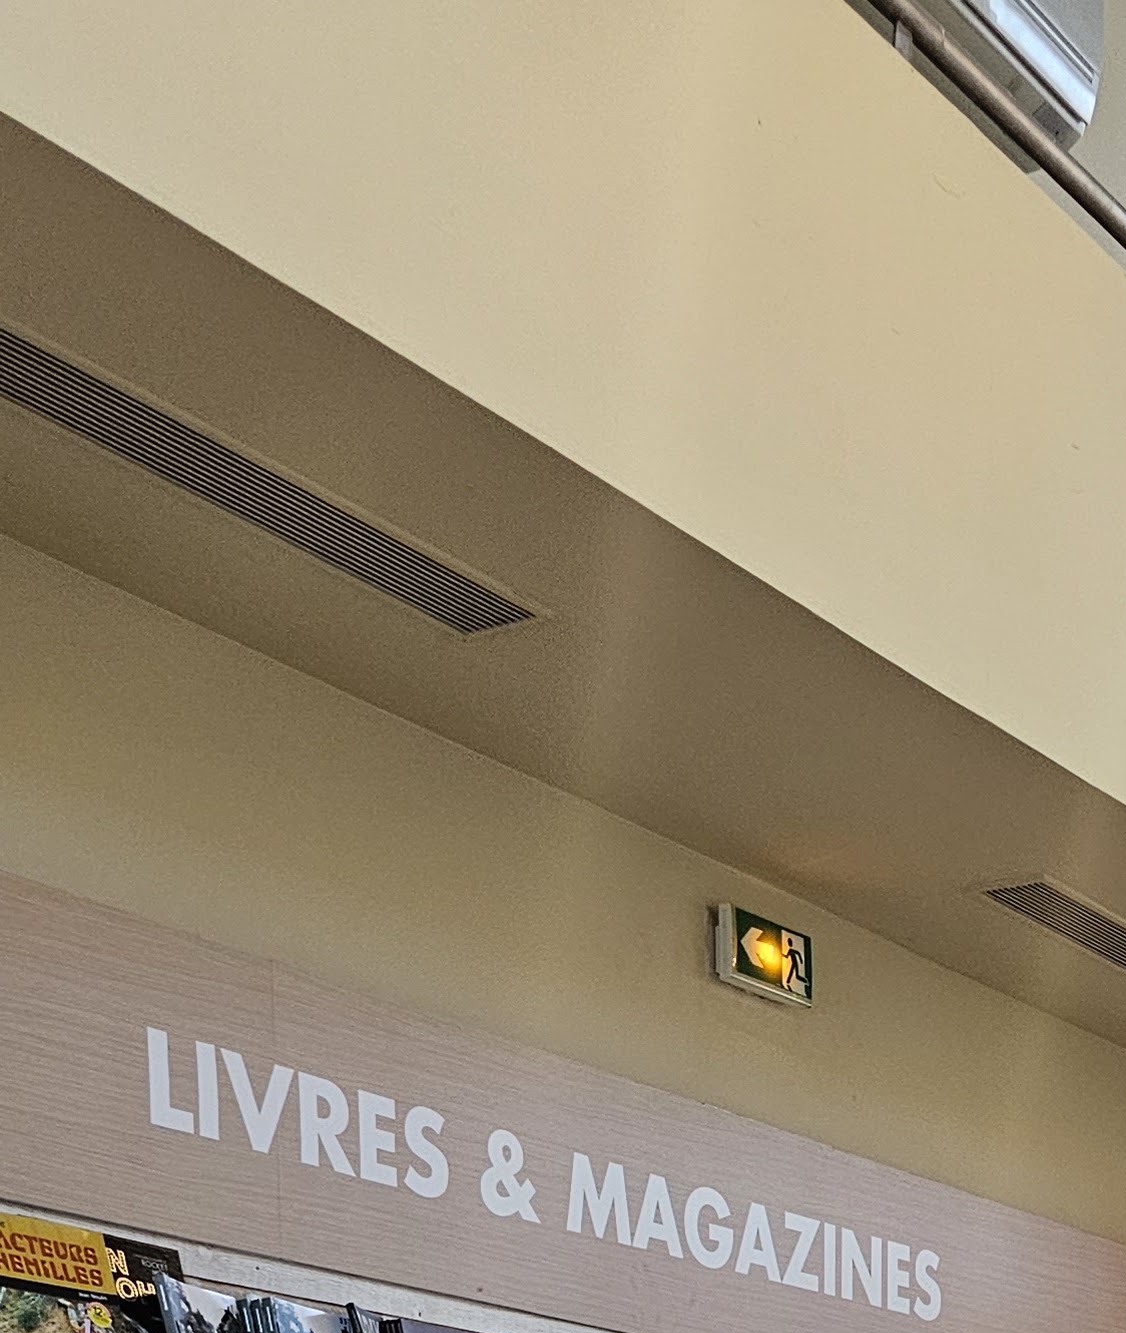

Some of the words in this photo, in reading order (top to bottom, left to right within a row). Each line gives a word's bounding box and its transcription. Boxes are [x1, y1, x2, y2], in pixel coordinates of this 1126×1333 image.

[145, 1026, 450, 1199] LIVRES
[481, 1129, 541, 1224] &
[566, 1152, 942, 1322] MAGAZINES
